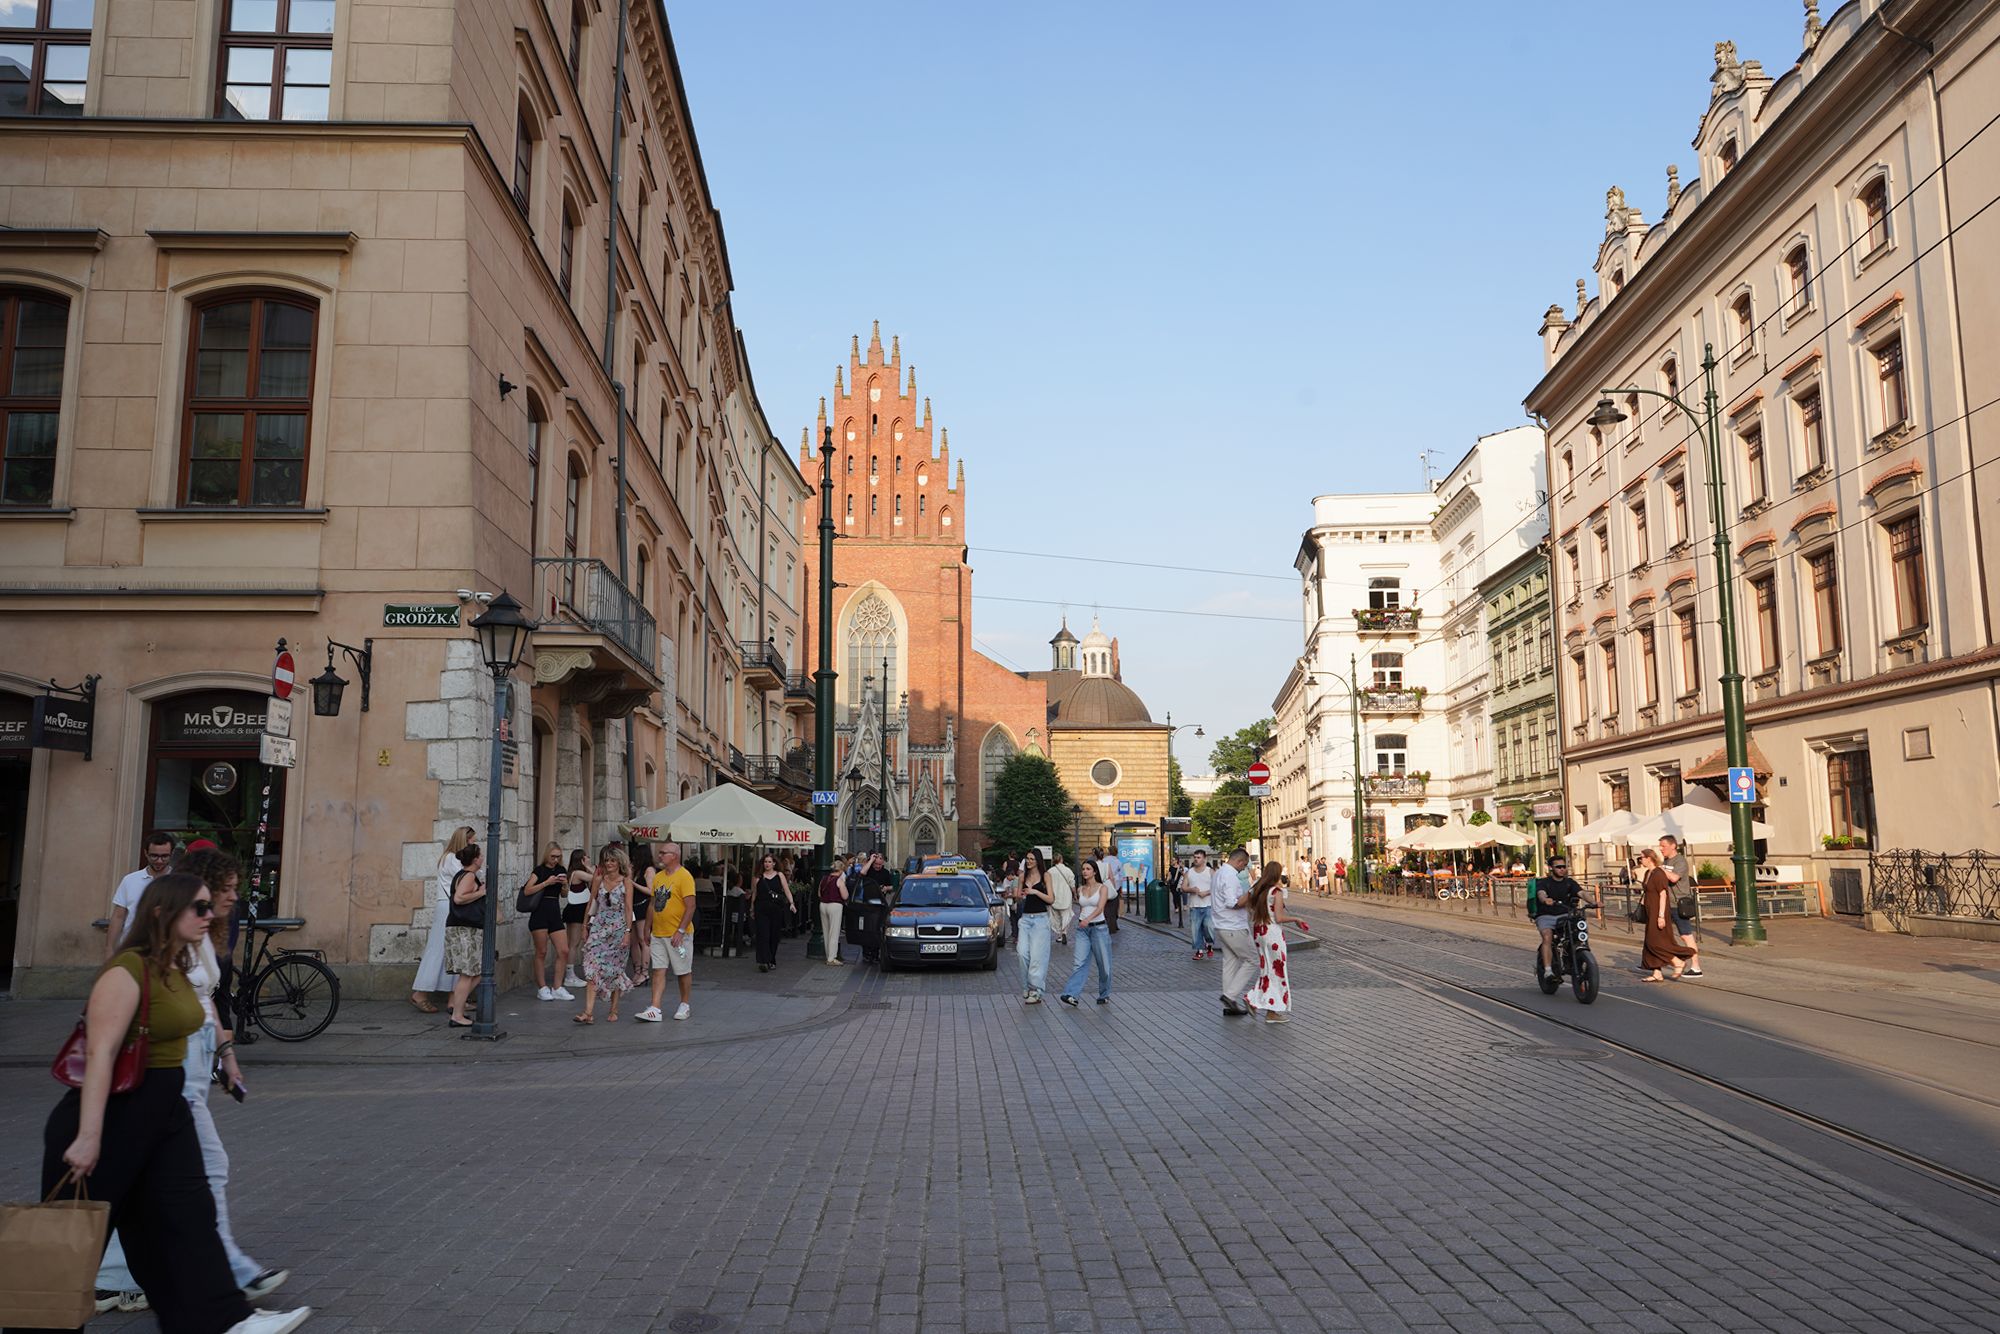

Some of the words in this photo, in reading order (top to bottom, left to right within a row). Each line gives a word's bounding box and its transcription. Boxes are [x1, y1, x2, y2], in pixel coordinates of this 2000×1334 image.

[385, 613, 458, 624] GRODZKA
[44, 715, 58, 726] MR
[66, 718, 88, 729] BEEF
[184, 712, 211, 725] MR
[233, 713, 267, 725] BEE
[183, 727, 236, 735] STEAKHOUSE
[814, 793, 837, 803] TAXI
[776, 830, 811, 842] TYSKIE
